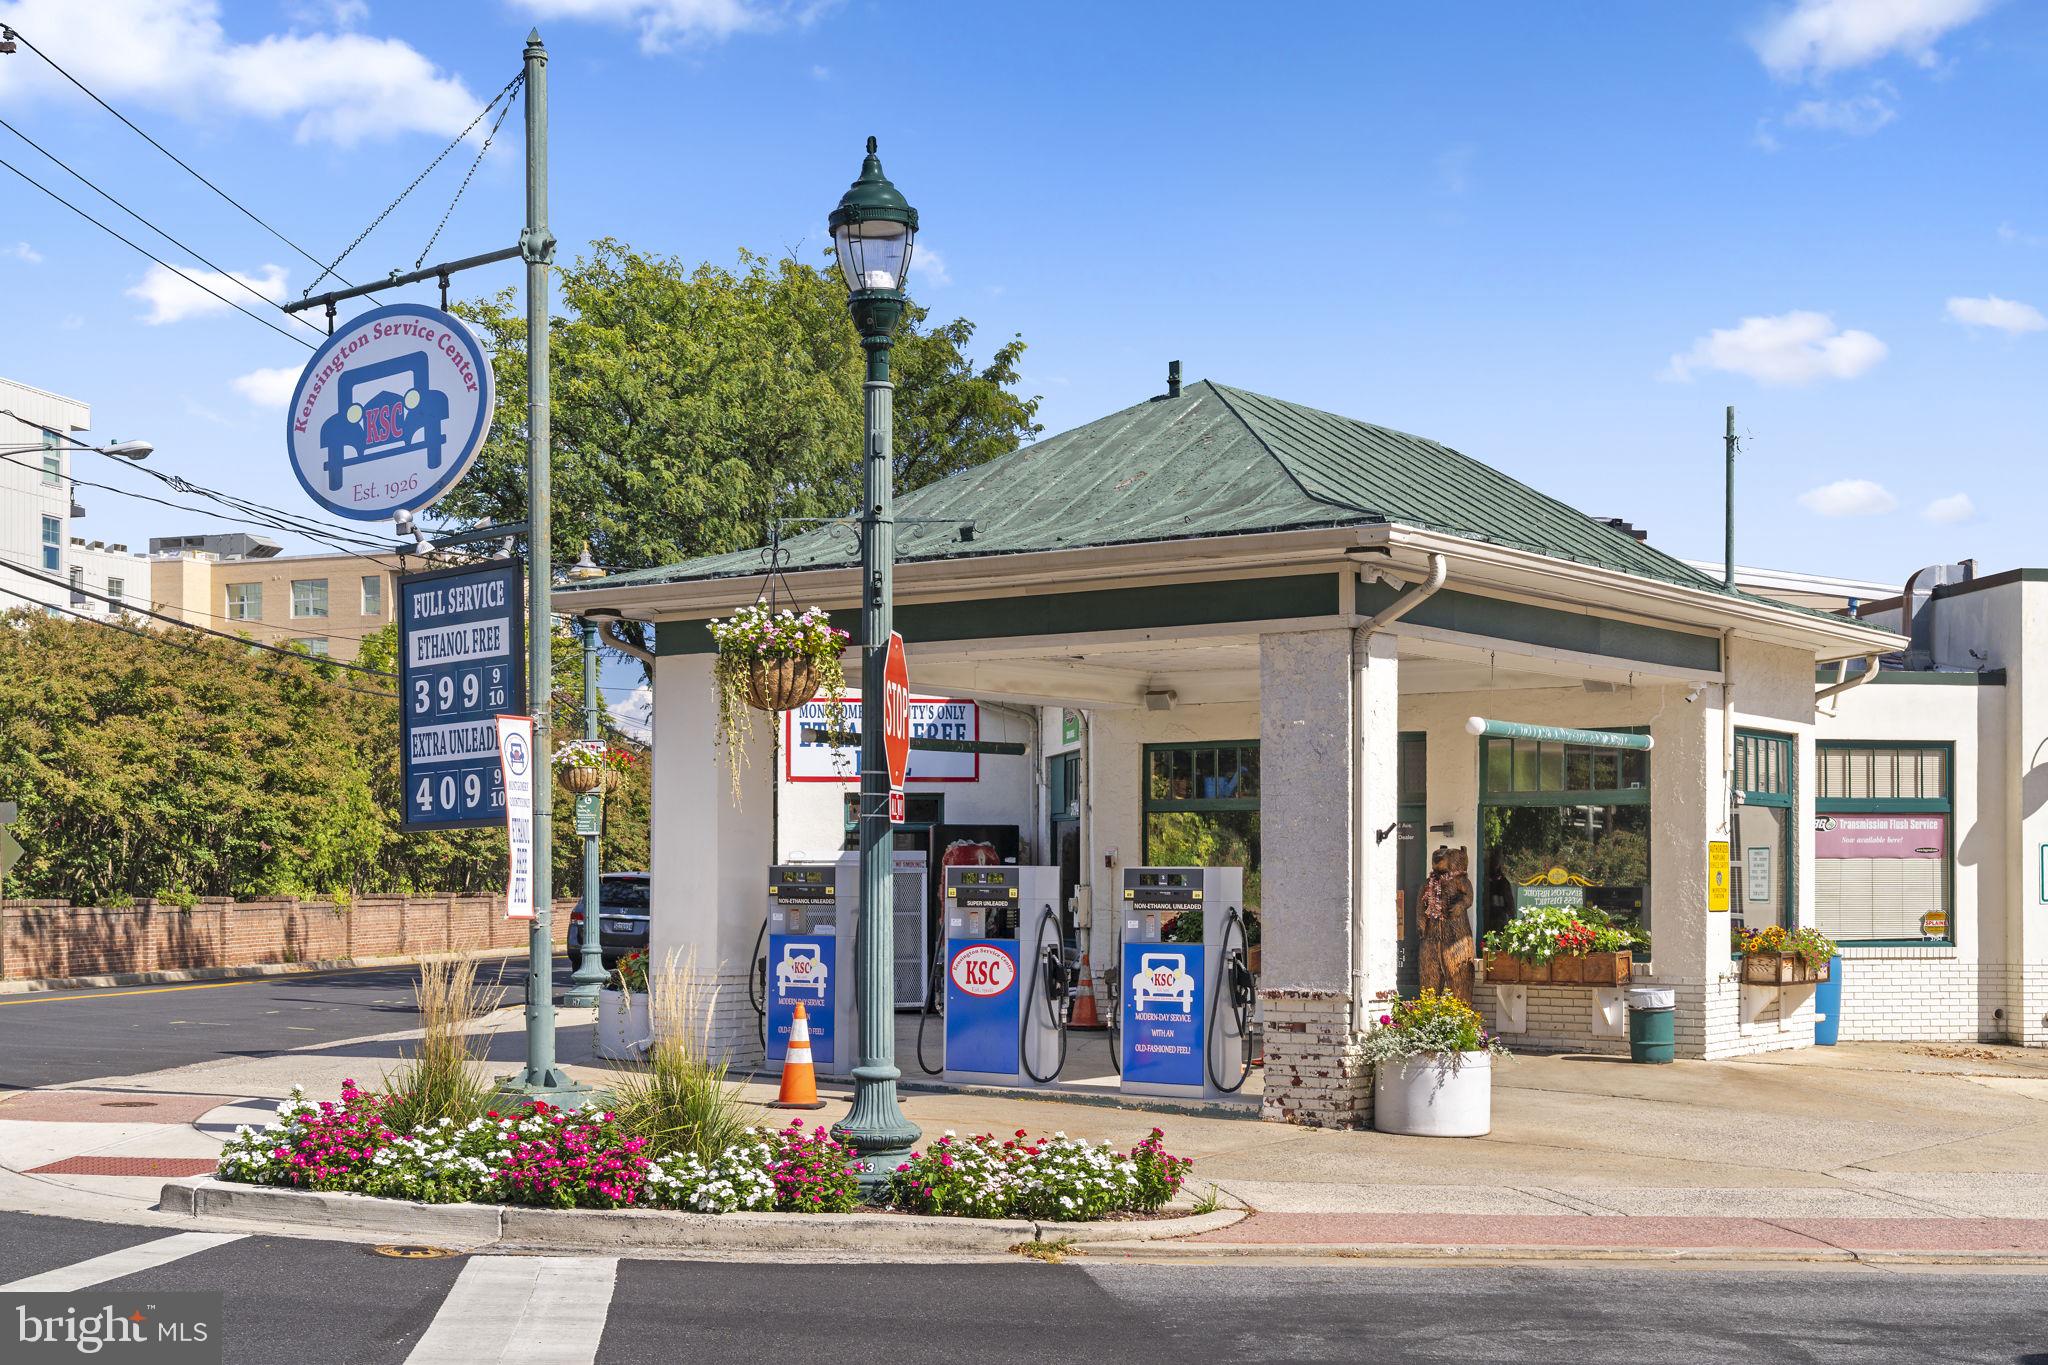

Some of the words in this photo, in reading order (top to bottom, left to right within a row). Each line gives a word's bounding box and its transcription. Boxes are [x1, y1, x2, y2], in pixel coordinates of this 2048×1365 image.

[295, 331, 370, 433] Kensington
[373, 319, 435, 341] Service
[437, 333, 478, 393] Center
[366, 402, 403, 444] KSC
[353, 482, 380, 502] Est.
[385, 473, 419, 499] 1926
[413, 590, 445, 619] FULL
[448, 580, 505, 614] SERVICE
[417, 630, 470, 661] ETHANOL
[472, 626, 501, 652] FREE
[886, 680, 908, 739] STOP
[938, 705, 966, 720] ONLY
[412, 726, 447, 758] EXTRA
[449, 720, 500, 753] UNLEAD
[1840, 819, 1888, 830] Transmission
[1890, 819, 1908, 830] Flush
[1910, 819, 1938, 830] Service
[1856, 836, 1885, 844] available
[1134, 902, 1172, 910] NON-ETHANOL
[794, 961, 811, 974] KSC
[952, 949, 979, 971] Kensington
[979, 948, 1001, 957] Service
[1001, 954, 1013, 973] Center
[965, 960, 1000, 986] KSC
[1154, 973, 1173, 987] KSC
[807, 999, 825, 1007] SERVICE
[1135, 1012, 1169, 1021] MODERN-DAY
[1170, 1013, 1192, 1022] SERVICE
[1151, 1028, 1166, 1037] WITH
[1166, 1029, 1175, 1037] AN
[1135, 1044, 1176, 1053] OLD-FASHIONED
[1176, 1045, 1191, 1054] FEEL!
